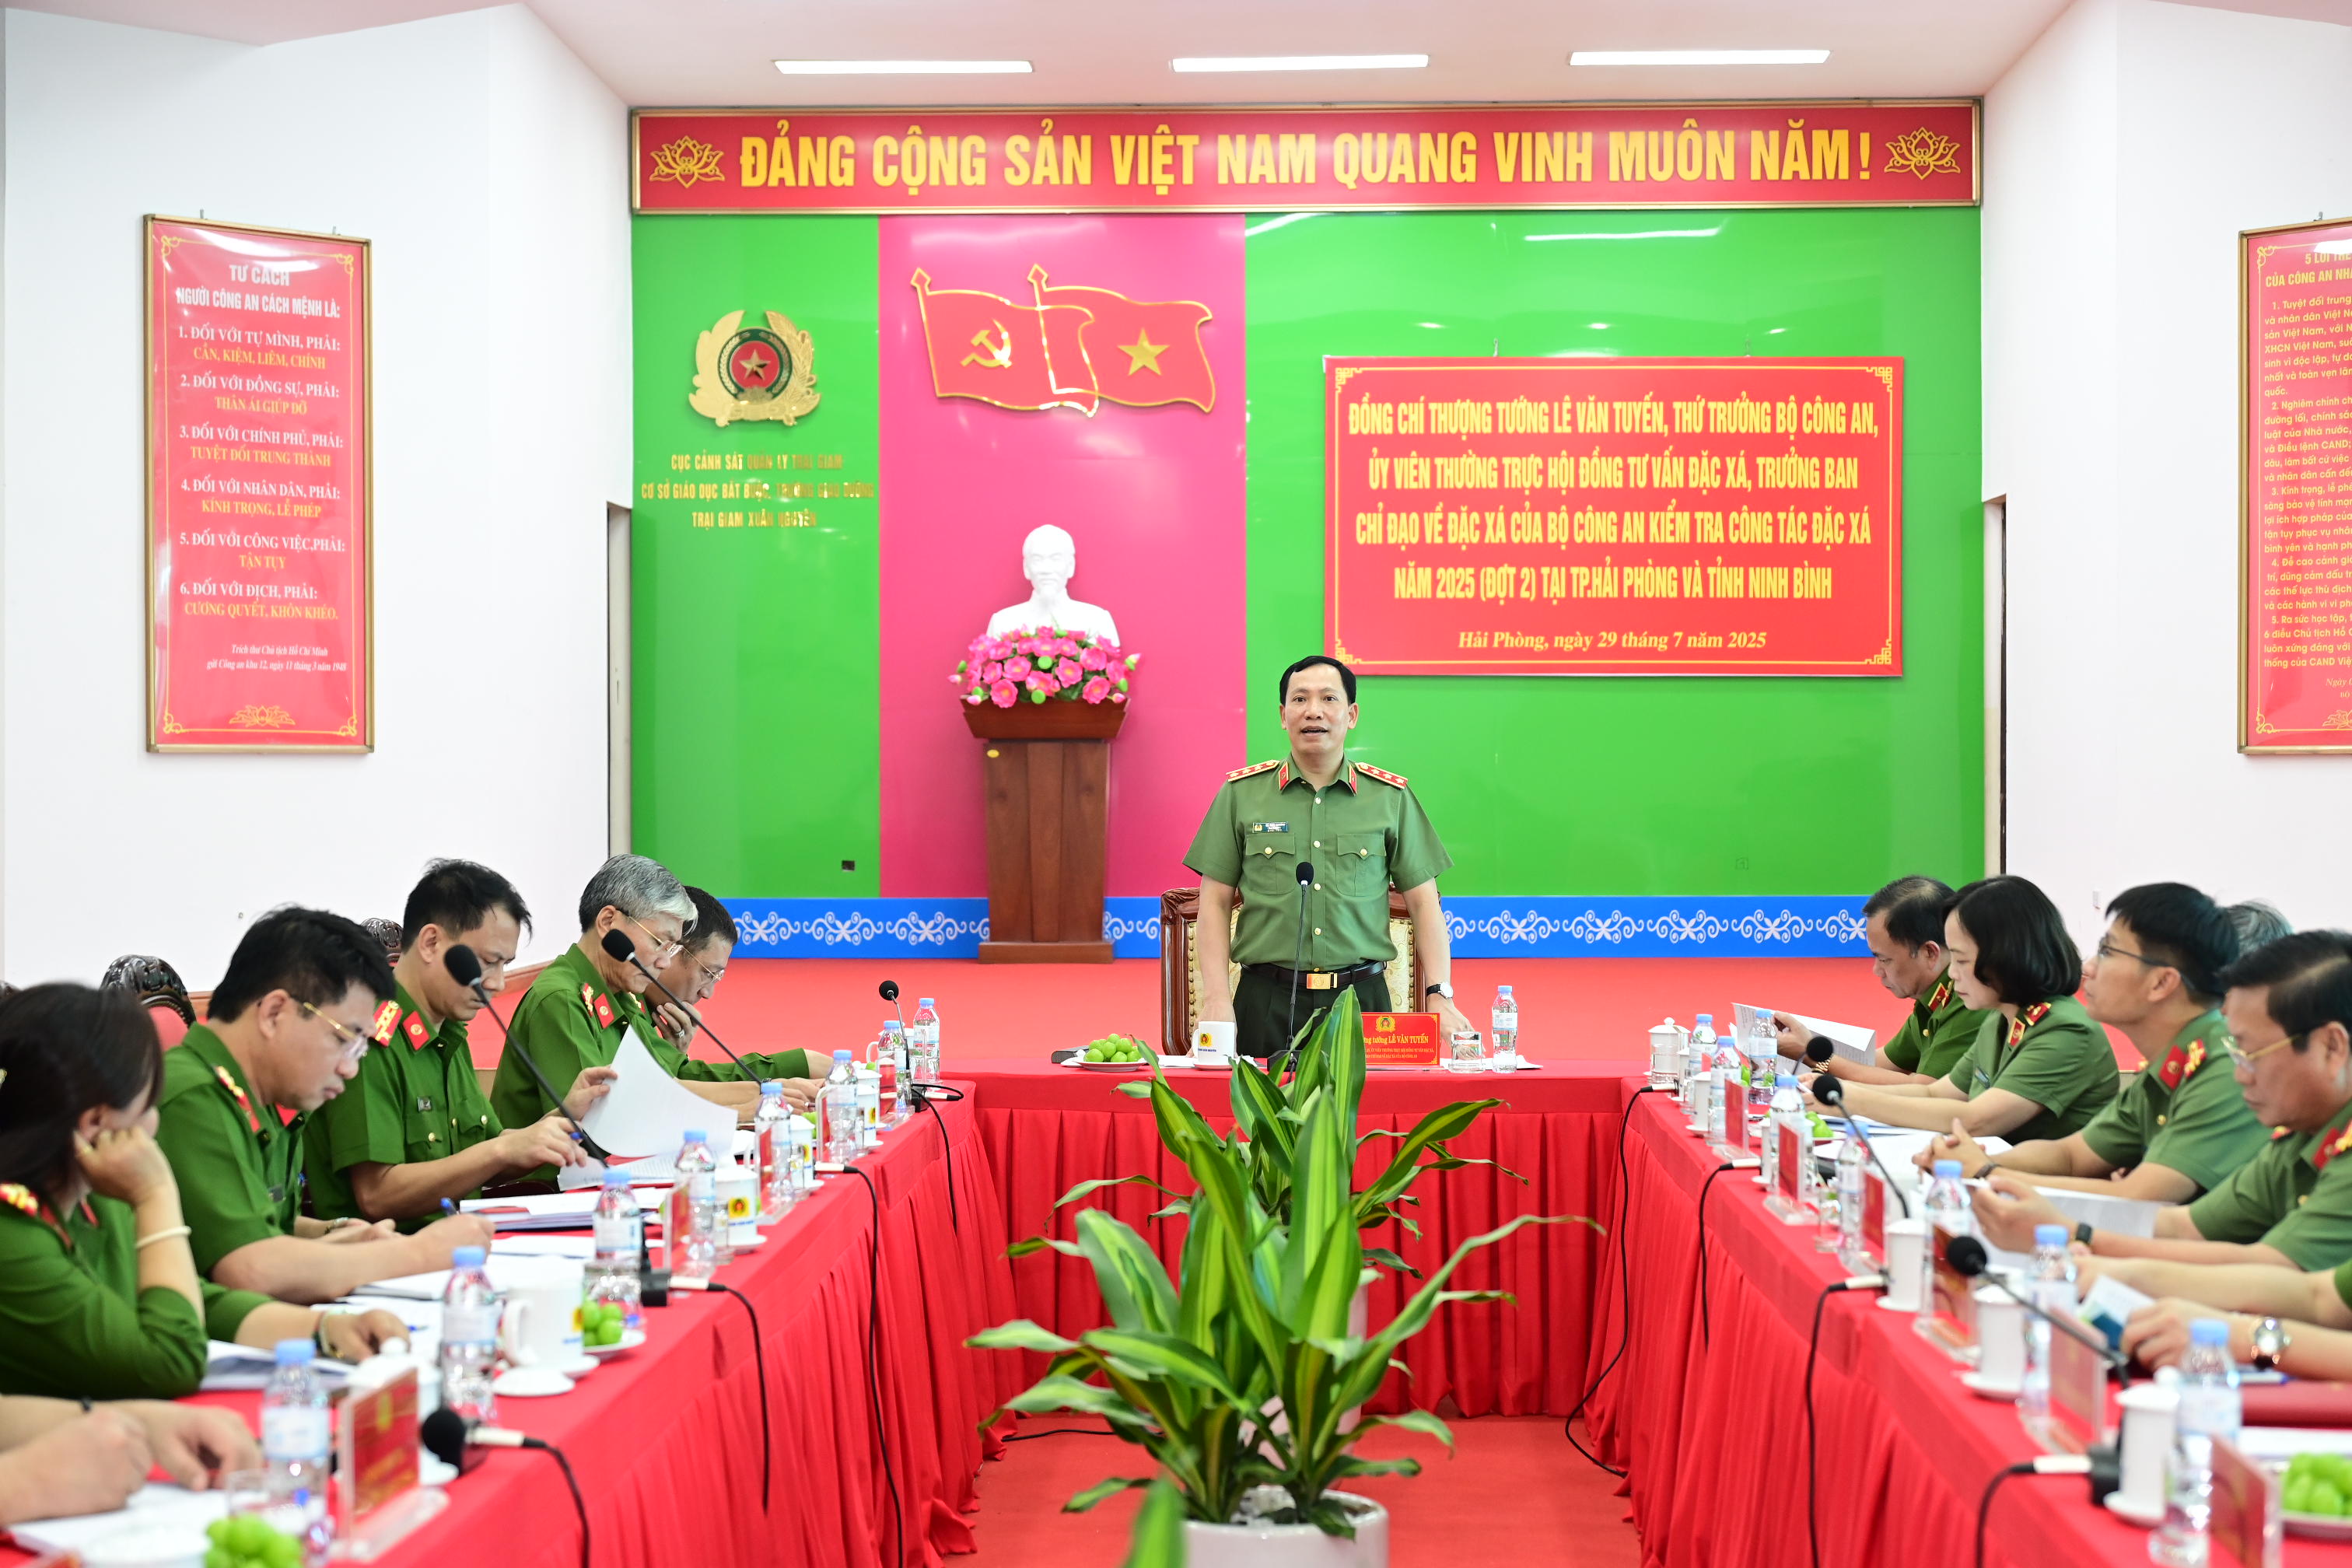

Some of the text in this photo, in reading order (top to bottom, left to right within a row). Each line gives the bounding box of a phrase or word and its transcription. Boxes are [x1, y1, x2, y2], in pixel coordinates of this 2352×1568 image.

[740, 119, 854, 187] ĐẢNG
[872, 125, 986, 195] CỘNG
[1003, 118, 1091, 186] SẢN
[1110, 124, 1200, 195] VIỆT
[1218, 134, 1316, 184] NAM
[1334, 132, 1476, 190] QUANG
[1494, 132, 1592, 182] VINH
[1608, 119, 1734, 181] MUÔN
[1751, 120, 1848, 180] NĂM
[2266, 271, 2333, 287] CỦA CÔNG AN
[213, 289, 241, 310] CÔNG
[245, 294, 259, 311] AN
[262, 293, 289, 313] CÁCH
[292, 296, 322, 318] MỆNH
[325, 298, 340, 318] LÀ:
[2283, 299, 2306, 310] Tuyệt
[2309, 296, 2324, 306] đối
[2278, 313, 2300, 324] nhân
[2303, 313, 2320, 321] dân
[2324, 310, 2340, 321] Việt
[179, 322, 340, 350] 1. ĐỐI VỚI TỰ MÌNH, PHẢI:
[2265, 324, 2343, 339] sản Việt Nam, với
[2265, 338, 2336, 353] XHCN Việt Nam,
[180, 370, 339, 397] 2. ĐỐI VỚI ĐỒNG SỰ, PHẢI:
[2265, 386, 2287, 397] quốc.
[1349, 391, 1878, 440] ĐỒNG CHÍ THƯỢNG TƯỚNG LÊ VĂN TUYẾN, THỨ TRƯỞNG BỘ CÔNG AN,
[180, 422, 343, 448] 3. ĐỐI VỚI CHÍNH PHỦ, PHẢI:
[2278, 442, 2297, 452] Điều
[2301, 442, 2319, 452] lệnh
[2322, 440, 2351, 449] CAND;
[671, 449, 743, 473] CỤC CẢNH SÁT
[1369, 446, 1857, 495] ỦY VIÊN THƯỜNG TRỰC HỘI ĐỒNG TƯ VẤN ĐẶC XÁ, TRƯỞNG BAN
[181, 474, 340, 499] 4. ĐỐI VỚI NHÂN DÂN, PHẢI:
[692, 512, 714, 530] TRẠI
[718, 512, 743, 527] GIAM
[1356, 499, 1871, 551] CHỈ ĐẠO VỀ ĐẶC XÁ CỦA BỘ CÔNG AN KIỂM TRA CÔNG TÁC ĐẶC XÁ
[1395, 556, 1832, 605] NĂM 2025 (ĐỢT 2) TẠI TP.HẢI PHÒNG VÀ TỈNH NINH BÌNH
[1459, 632, 1766, 651] Hải Phòng, ngày 29 tháng 7 năm 2025
[2272, 628, 2291, 638] điều
[2294, 628, 2312, 637] Chủ
[2315, 629, 2330, 639] tịch
[2333, 628, 2346, 636] Hồ
[2264, 642, 2350, 653] luôn xứng đáng với
[2264, 657, 2288, 669] thống
[2310, 657, 2335, 666] CAND
